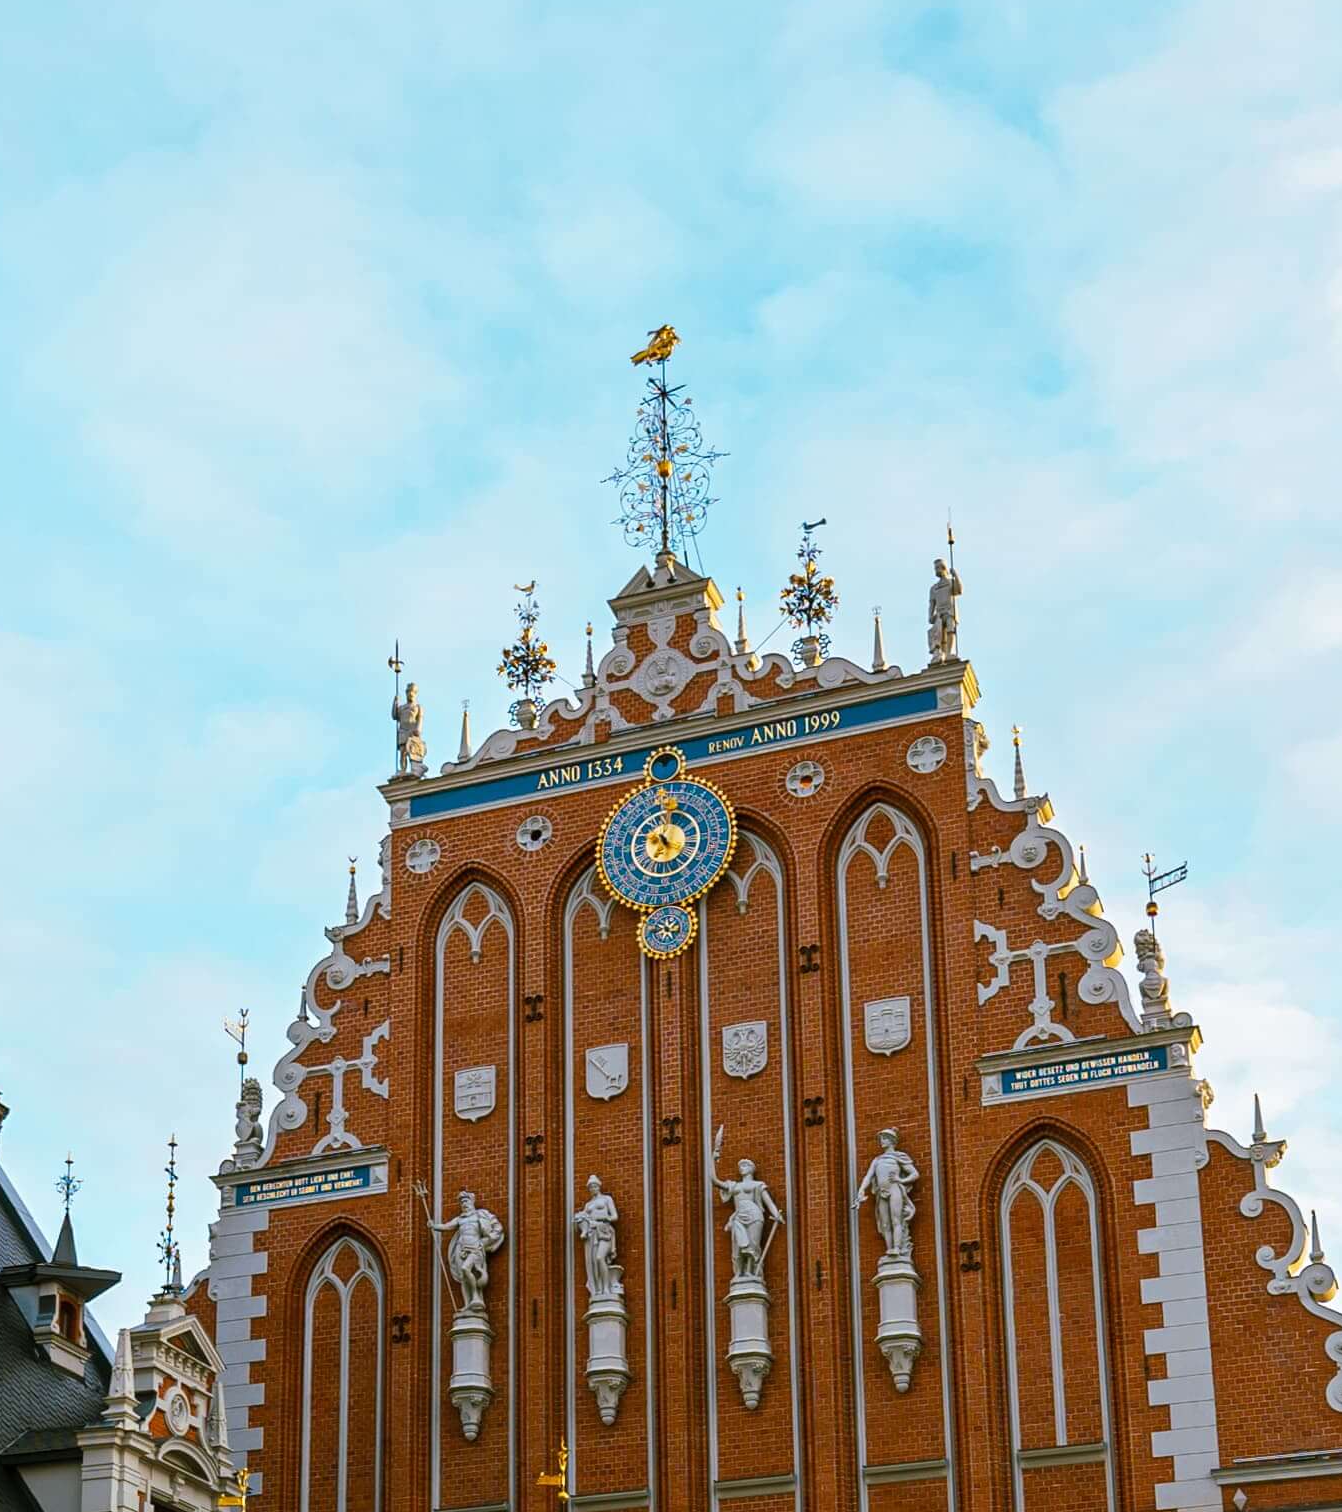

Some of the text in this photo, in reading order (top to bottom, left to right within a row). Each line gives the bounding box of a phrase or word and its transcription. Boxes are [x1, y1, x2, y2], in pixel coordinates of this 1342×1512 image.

[537, 764, 581, 790] ANNO
[587, 756, 623, 779] 1334
[751, 720, 797, 746] ANNO
[804, 710, 841, 734] 1999
